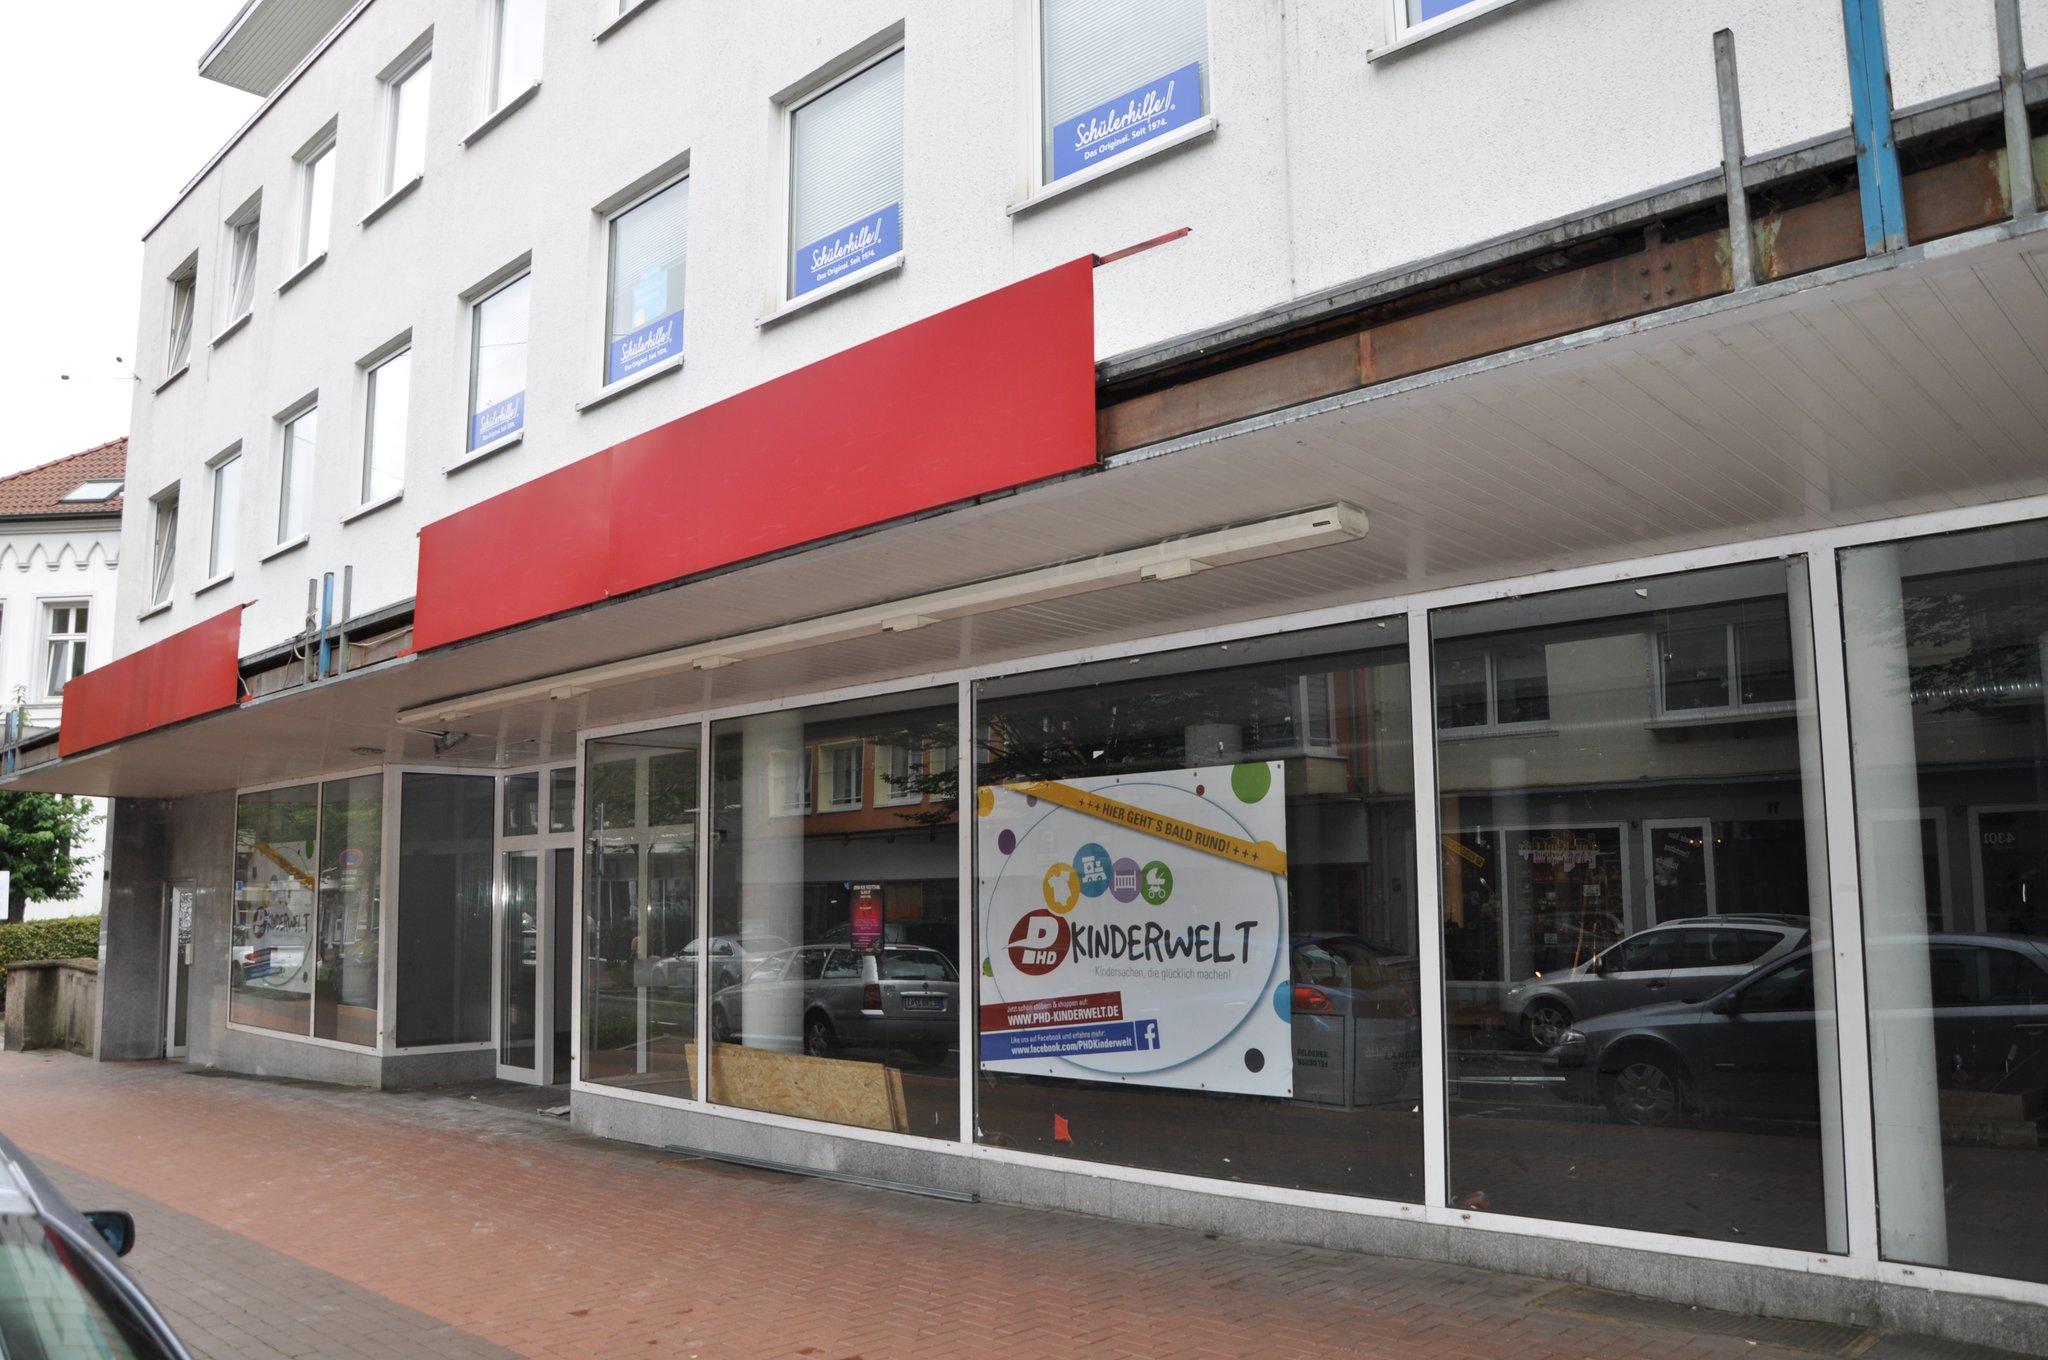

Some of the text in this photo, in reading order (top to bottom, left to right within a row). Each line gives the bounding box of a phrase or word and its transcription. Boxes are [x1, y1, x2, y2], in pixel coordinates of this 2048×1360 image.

[1084, 118, 1167, 160] Das Original. Seit 1974.
[816, 271, 827, 281] Das
[827, 261, 849, 276] Original.
[850, 256, 860, 266] Seit
[1102, 802, 1124, 821] HIER
[1165, 823, 1193, 842] BALD
[1195, 832, 1230, 854] RUND!
[1070, 921, 1258, 964] KINDERWELT
[1095, 966, 1232, 981] Kindersachen, die glücklich machen!
[1007, 1005, 1018, 1013] Jetzt
[1018, 1003, 1033, 1012] schon
[1058, 999, 1079, 1009] shoppen
[1007, 1005, 1119, 1026] WWW.PHD-KINDERWELT.DE
[1011, 1036, 1020, 1044] Like
[1038, 1032, 1061, 1042] Facebook
[1062, 1032, 1072, 1040] und
[1072, 1031, 1091, 1040] erfahre
[1011, 1037, 1132, 1055] www.facebook.com/PHDKinderwelt
